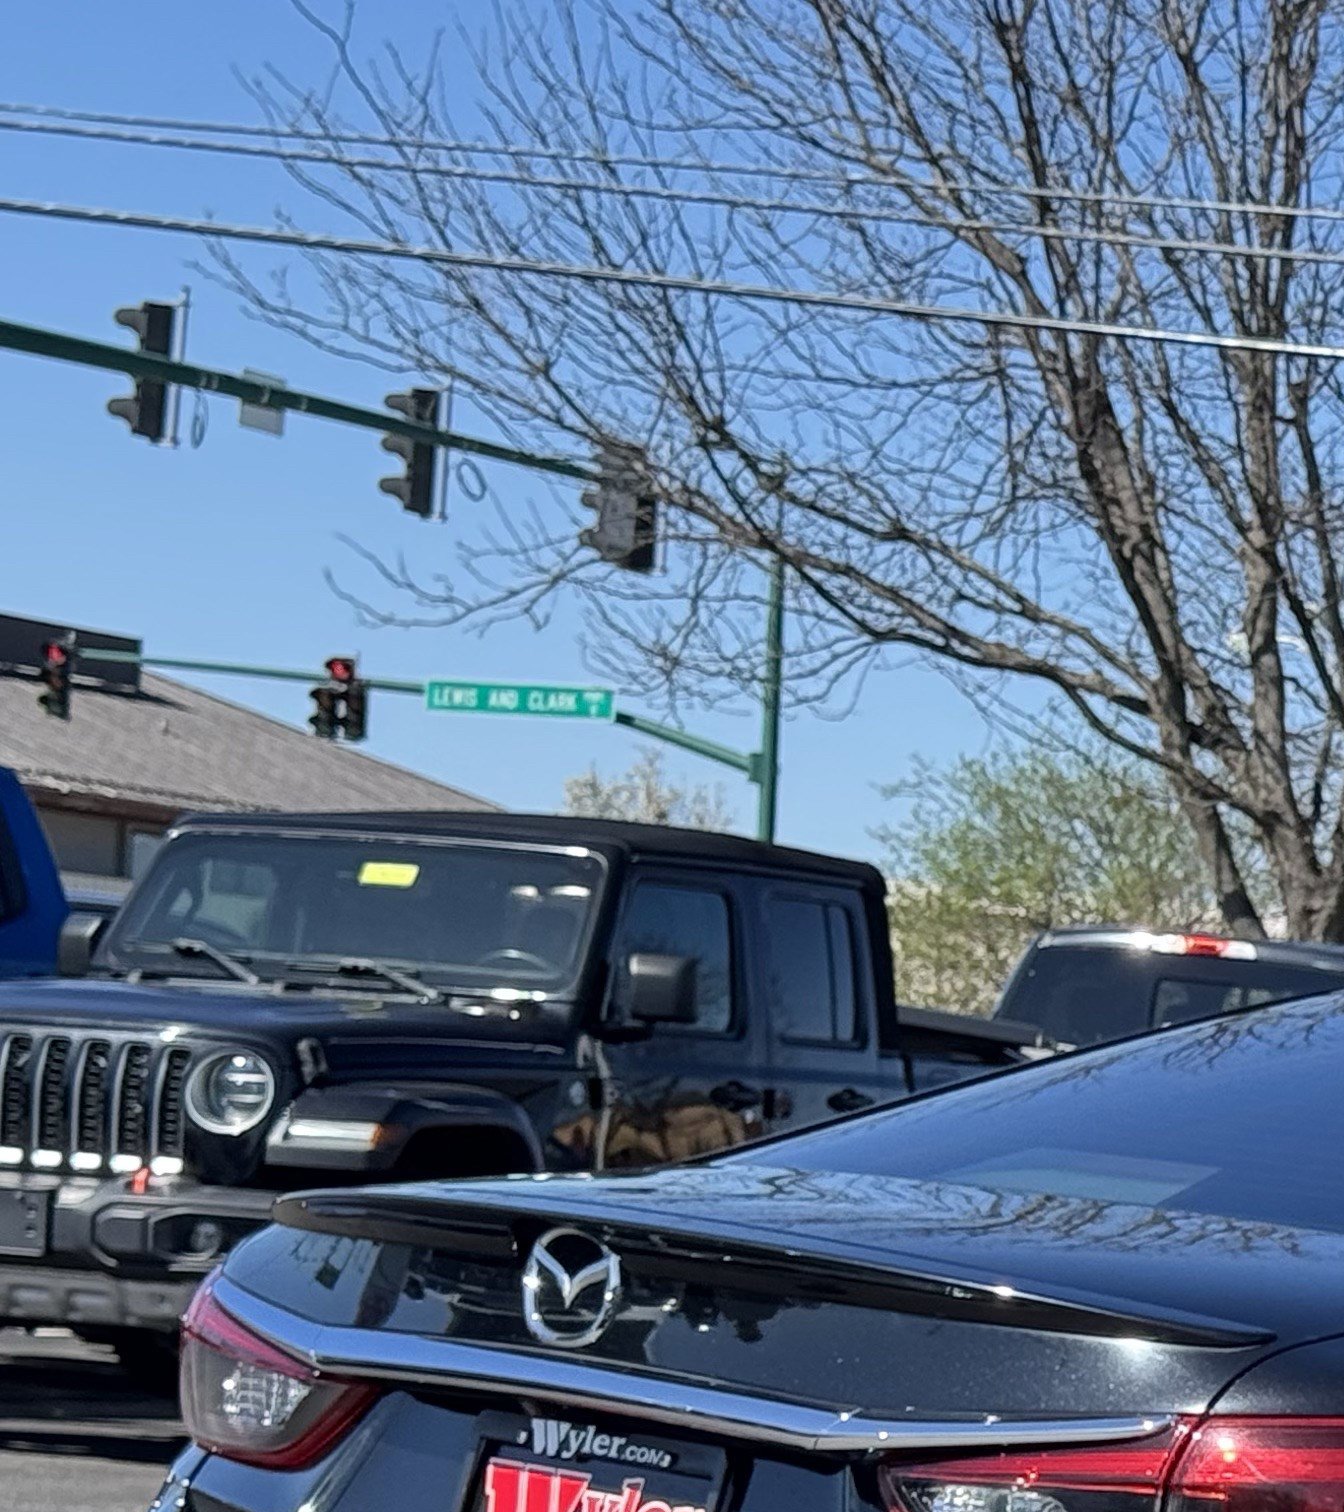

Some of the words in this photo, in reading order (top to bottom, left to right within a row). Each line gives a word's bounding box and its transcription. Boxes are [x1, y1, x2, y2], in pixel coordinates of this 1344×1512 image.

[433, 686, 478, 708] LEWIS
[488, 688, 519, 710] AND
[527, 690, 577, 712] CLARK
